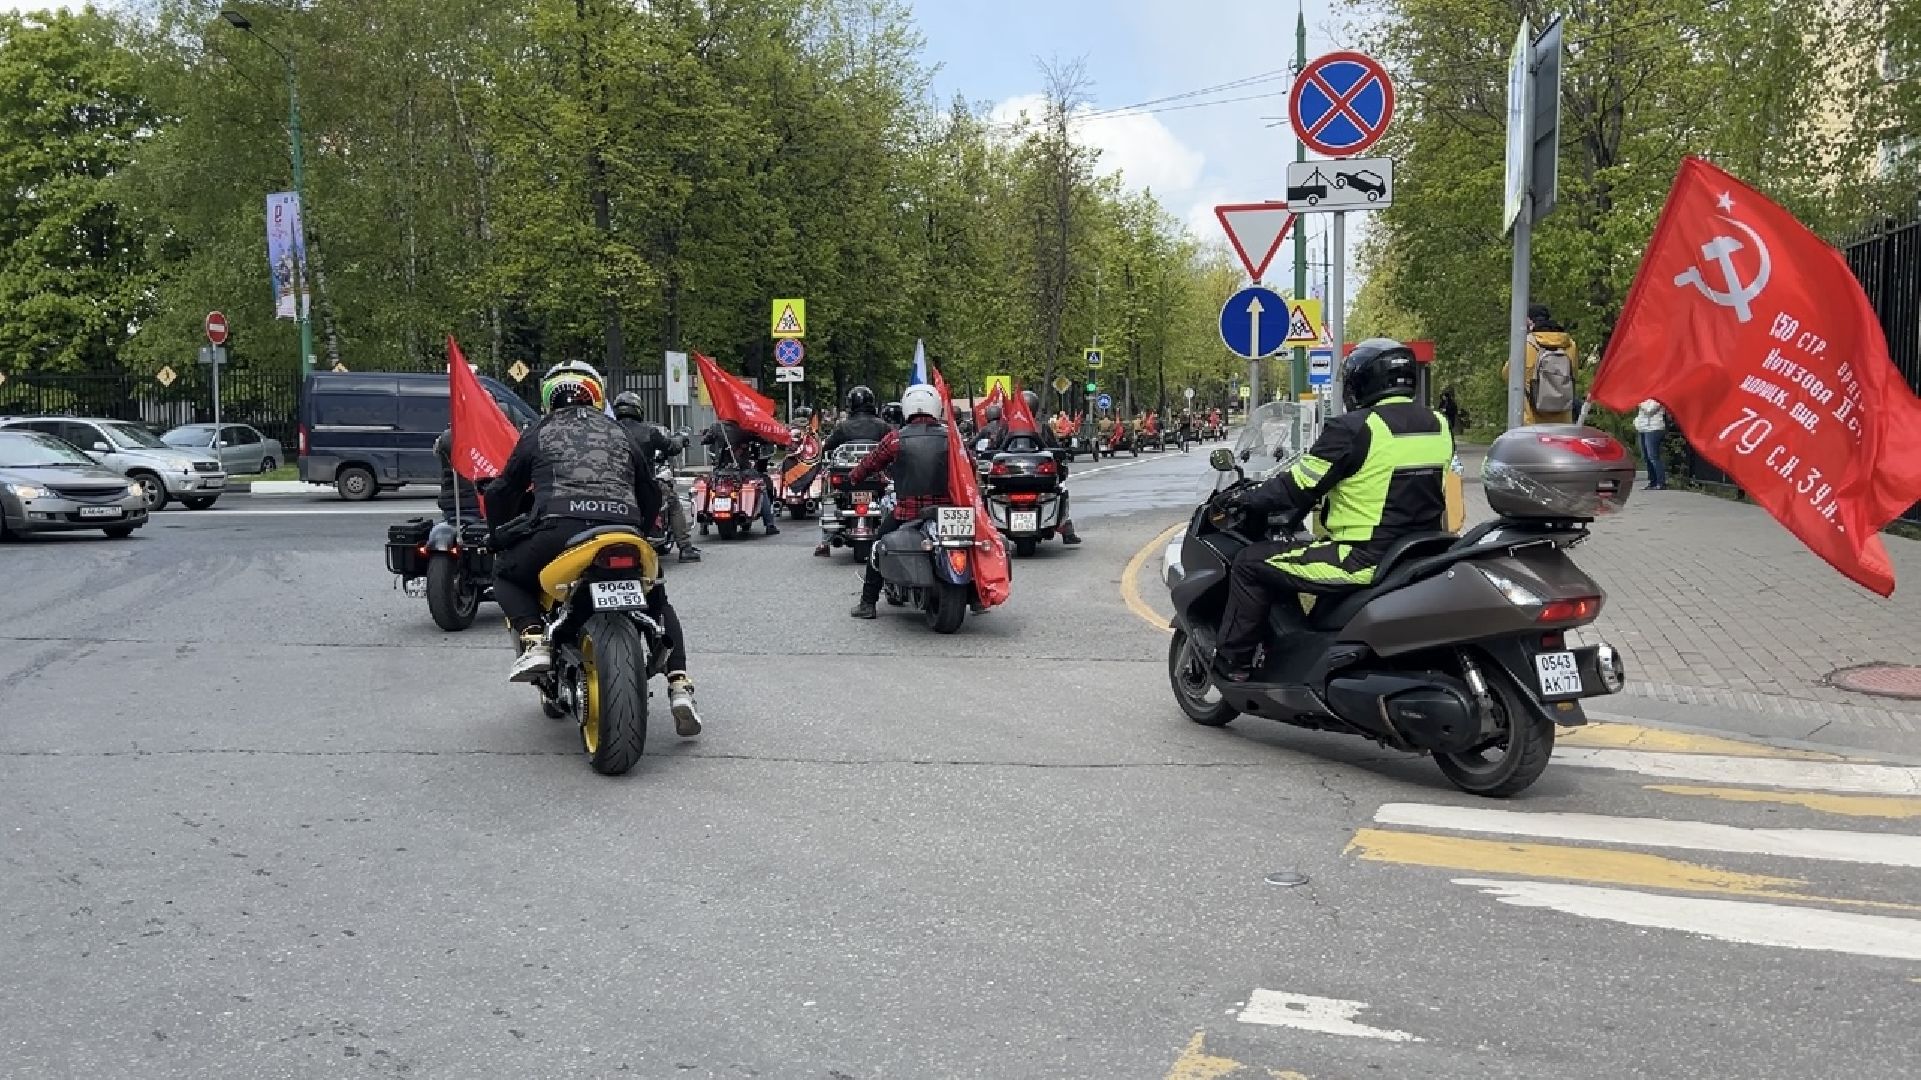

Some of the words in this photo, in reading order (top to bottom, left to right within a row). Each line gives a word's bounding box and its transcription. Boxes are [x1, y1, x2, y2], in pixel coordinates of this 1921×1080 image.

[1769, 311, 1799, 341] 150
[1719, 407, 1773, 454] 79
[943, 509, 970, 520] 5353
[1541, 654, 1571, 670] 0543
